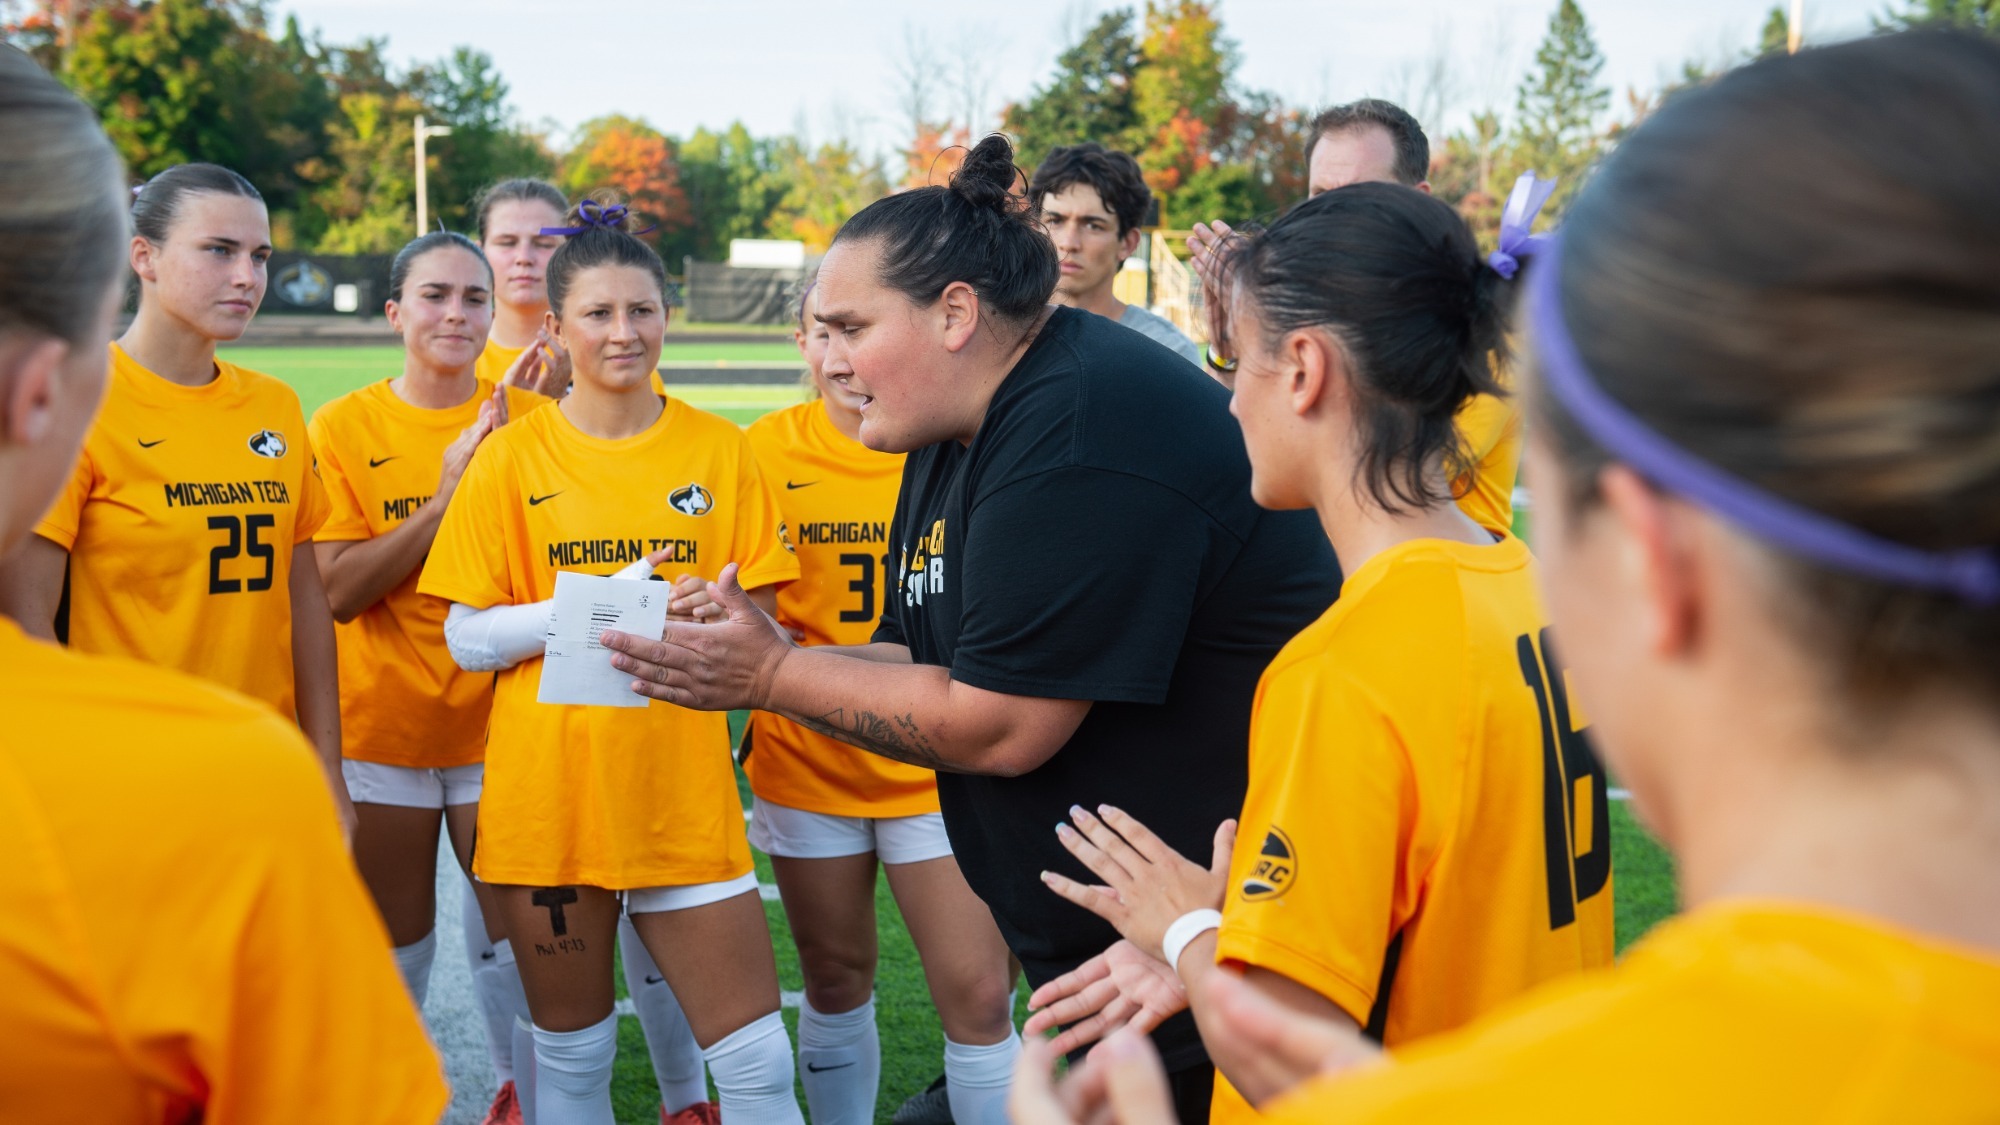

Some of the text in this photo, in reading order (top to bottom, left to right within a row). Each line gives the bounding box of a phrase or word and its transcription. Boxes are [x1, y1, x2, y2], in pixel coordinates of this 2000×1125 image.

[164, 480, 290, 508] MICHIGAN TECH
[384, 496, 432, 521] MIC
[799, 522, 886, 545] MICHIGAN
[207, 513, 275, 595] 25
[548, 539, 642, 567] MICHIGAN
[535, 938, 586, 957] Phil 4:13
